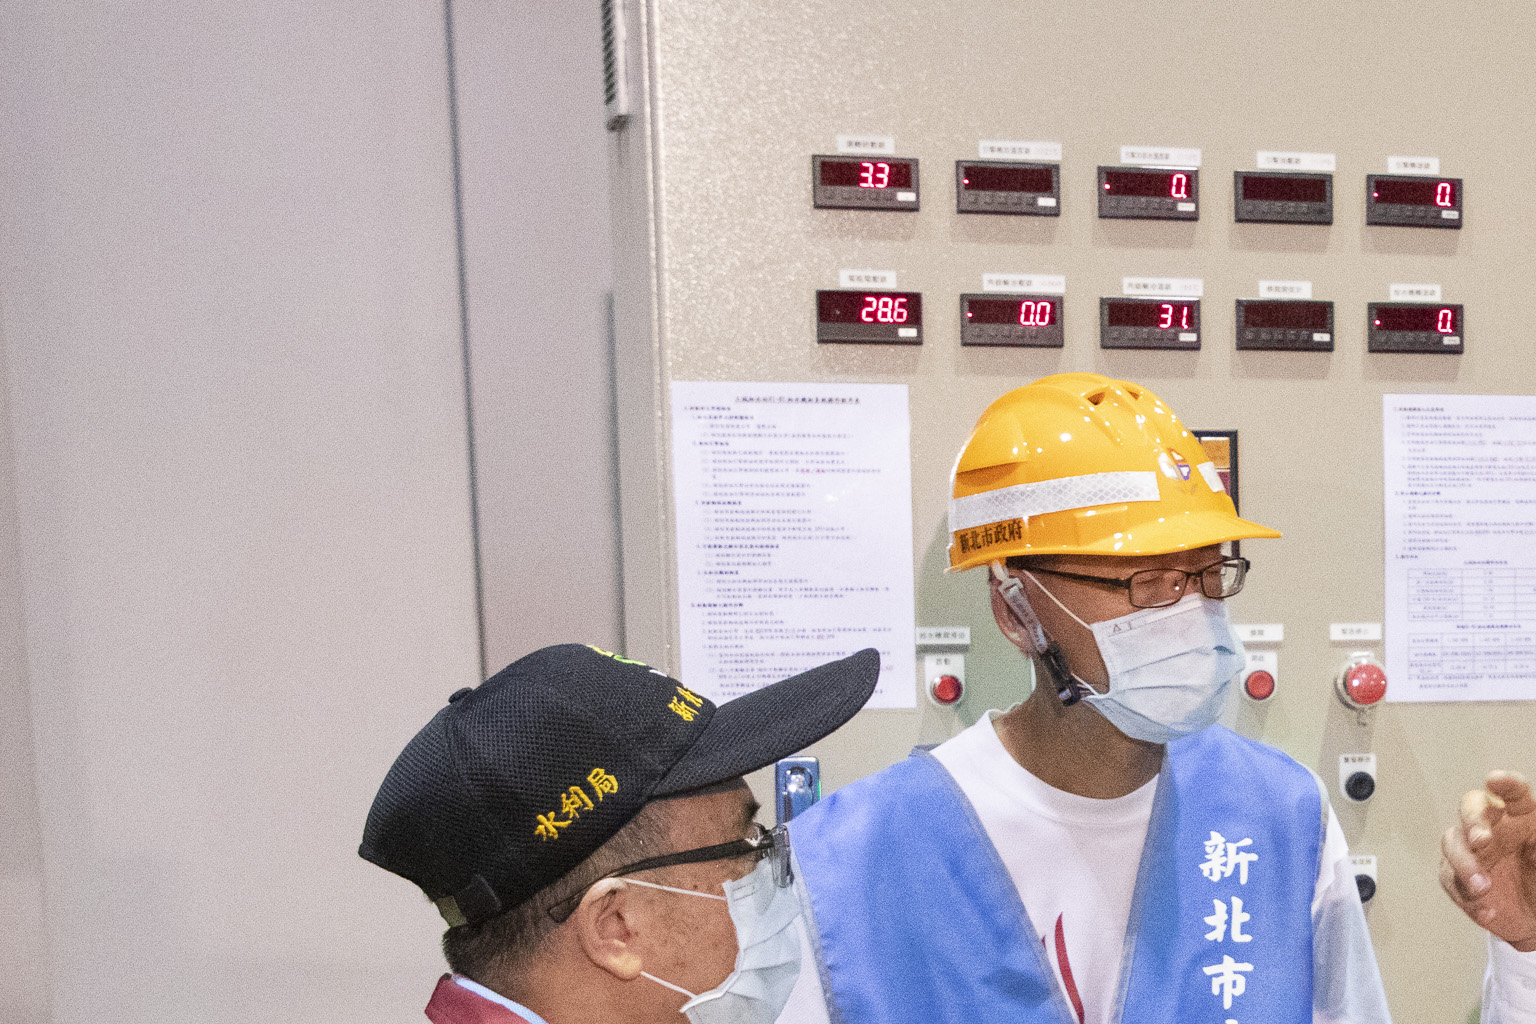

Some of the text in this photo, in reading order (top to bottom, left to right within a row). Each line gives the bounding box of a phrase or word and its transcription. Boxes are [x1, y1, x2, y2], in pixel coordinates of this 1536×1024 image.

[959, 520, 1022, 553] 新北市政府
[534, 767, 619, 842] 水利局
